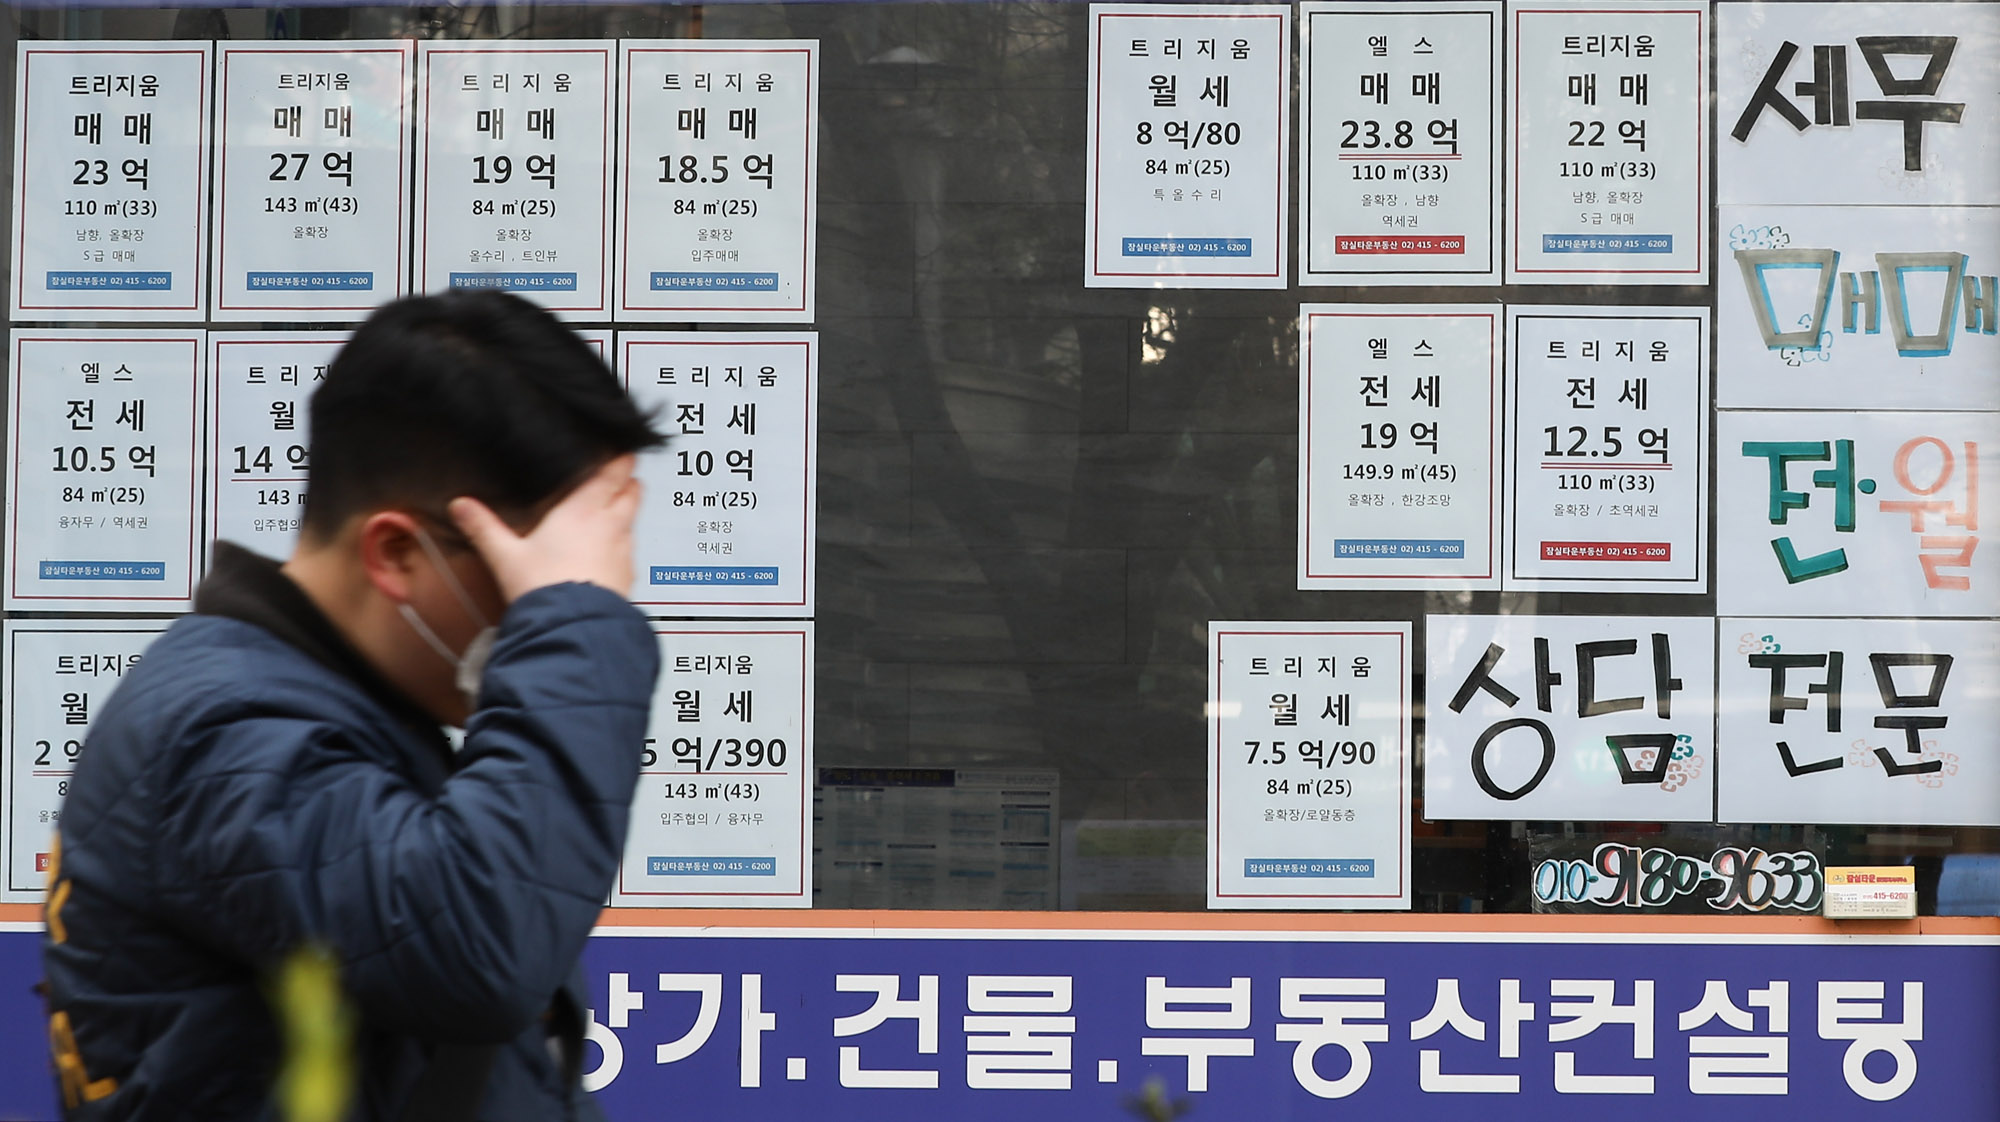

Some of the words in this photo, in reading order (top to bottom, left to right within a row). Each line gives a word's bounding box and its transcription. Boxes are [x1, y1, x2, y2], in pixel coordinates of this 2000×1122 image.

[1562, 35, 1655, 58] 트리지움
[69, 75, 159, 97] 트리지움
[278, 73, 350, 91] 트리지움
[1730, 37, 1966, 171] 세무
[1137, 122, 1152, 145] 8
[1341, 120, 1413, 148] 23.8
[1568, 121, 1605, 146] 22
[73, 160, 108, 185] 23
[269, 153, 309, 181] 27
[473, 156, 512, 184] 19
[659, 155, 728, 183] 18.5
[1146, 159, 1168, 174] 84
[1353, 165, 1385, 180] 110
[1560, 162, 1593, 177] 110
[65, 200, 97, 215] 110
[265, 197, 297, 212] 143
[473, 200, 494, 215] 84
[674, 199, 696, 214] 84
[1734, 249, 1998, 357] 매매
[1361, 423, 1397, 449] 19
[1545, 426, 1622, 457] 12.5
[53, 446, 115, 472] 10.5
[234, 446, 273, 473] 14
[677, 451, 713, 476] 10
[1344, 464, 1393, 479] 149.9
[1559, 474, 1592, 490] 110
[63, 487, 84, 502] 84
[258, 490, 290, 505] 143
[673, 491, 695, 507] 84
[673, 655, 753, 675] 트리지움
[1448, 633, 1683, 800] 상담
[1748, 651, 1953, 777] 전문
[35, 740, 50, 765] 2
[1245, 741, 1286, 764] 7.5
[665, 783, 697, 798] 143
[1267, 779, 1289, 794] 84
[1534, 842, 1823, 911] 010-9180-9633
